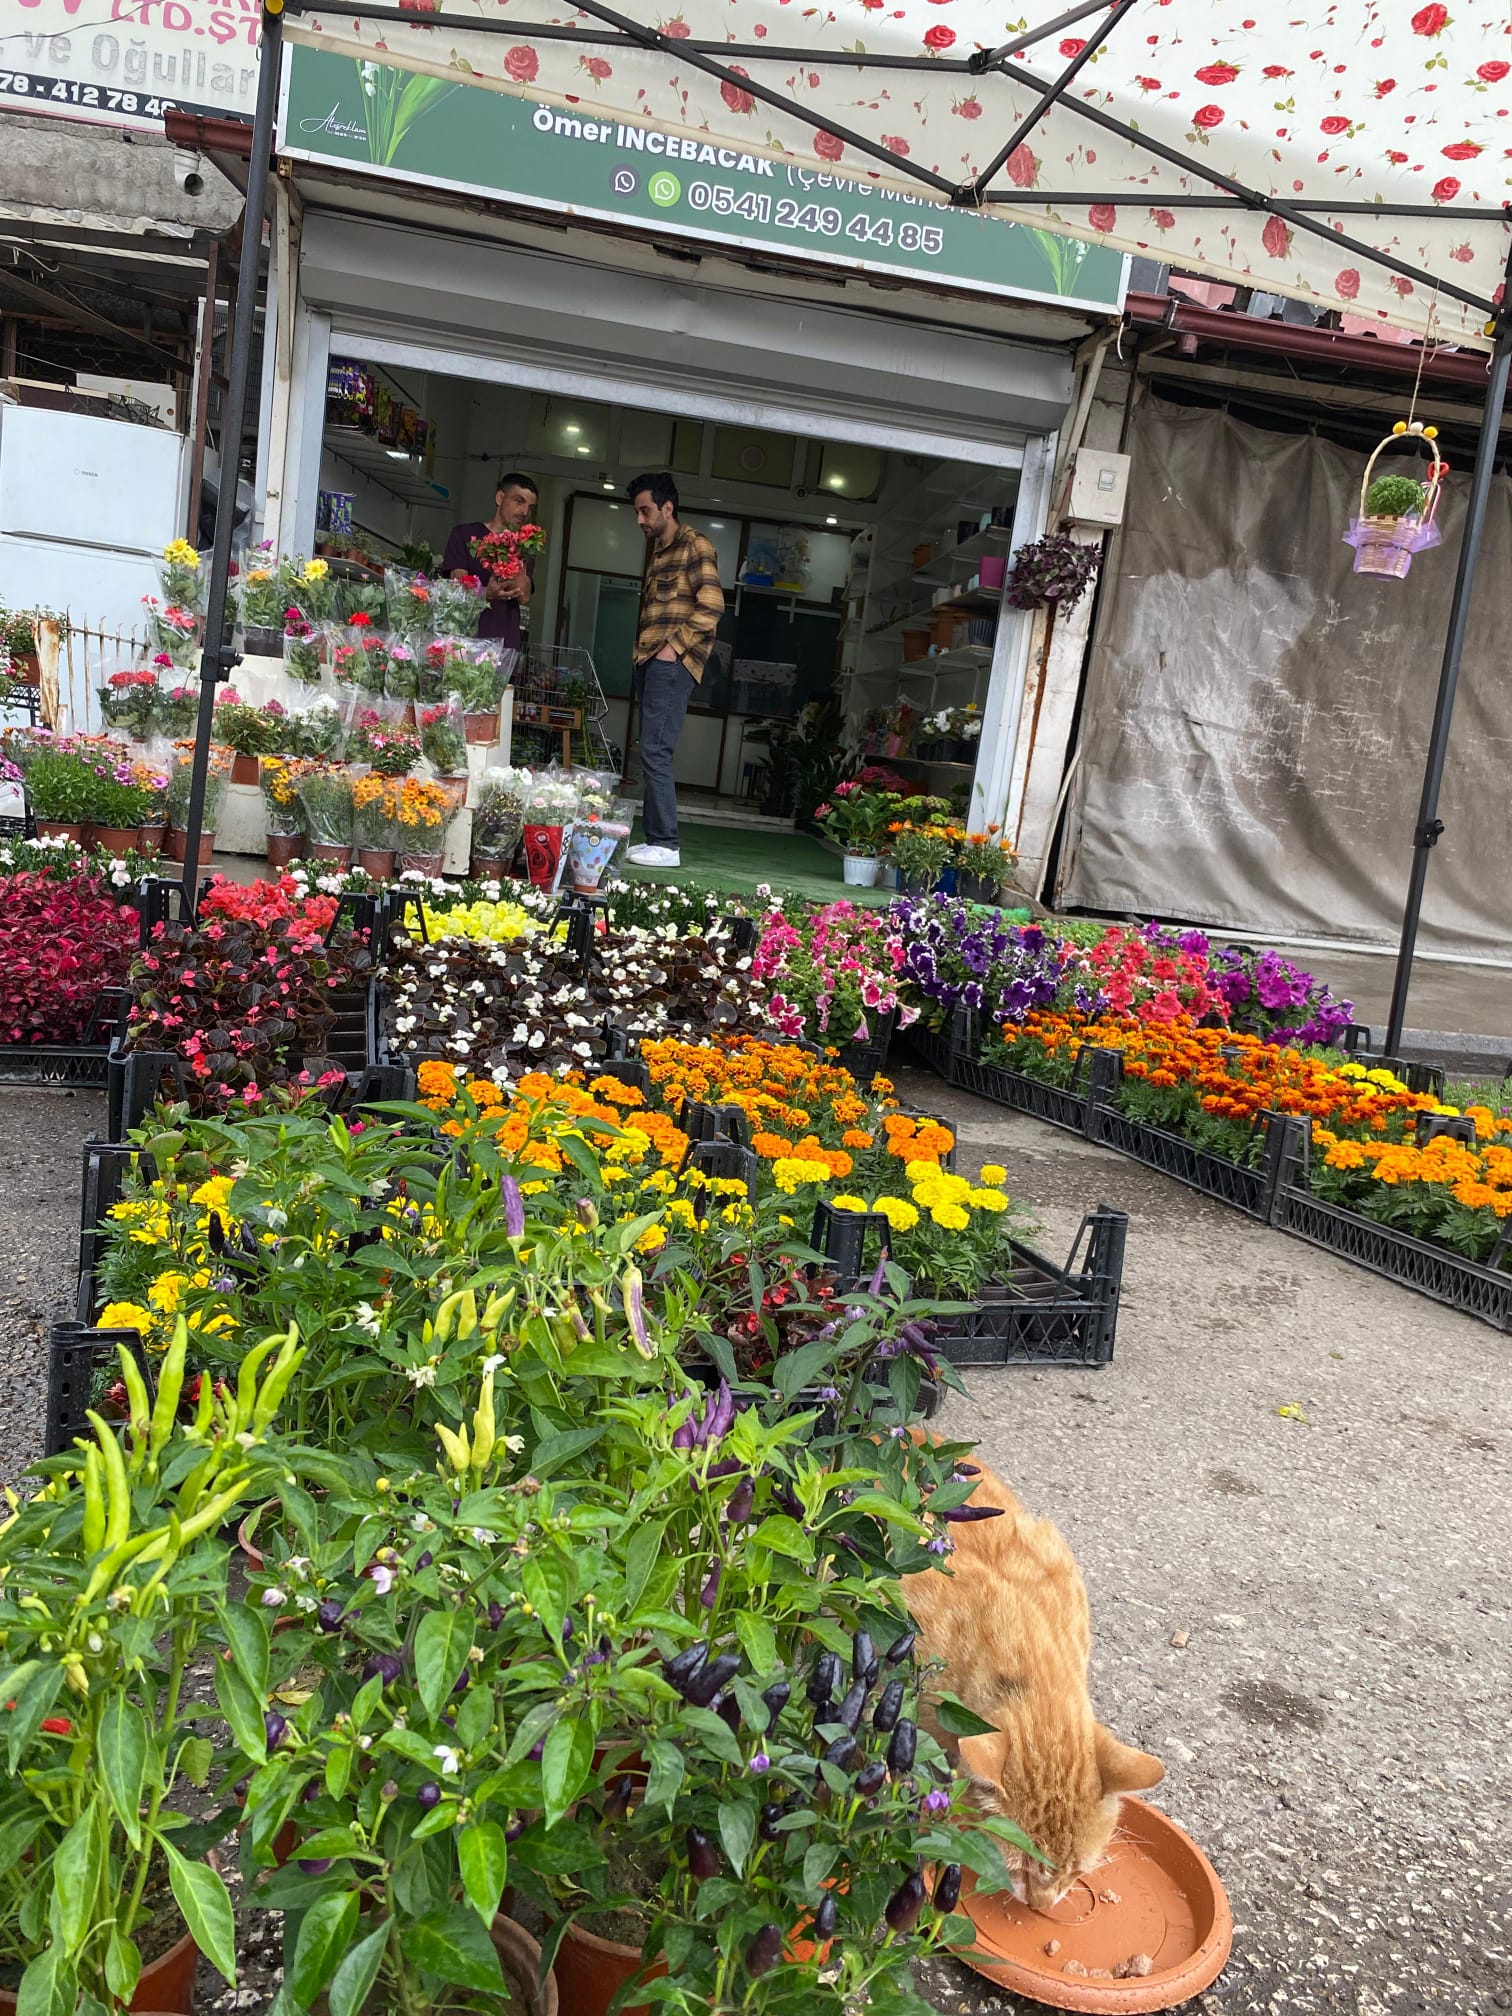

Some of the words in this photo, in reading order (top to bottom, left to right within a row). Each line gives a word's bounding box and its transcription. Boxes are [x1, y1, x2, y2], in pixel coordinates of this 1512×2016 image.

[24, 31, 72, 64] ve
[51, 82, 99, 105] 412
[107, 91, 138, 112] 78
[533, 103, 612, 144] Ömer
[688, 181, 771, 223] 0541
[775, 199, 843, 235] 249
[846, 213, 893, 246] 44
[898, 225, 944, 255] 85
